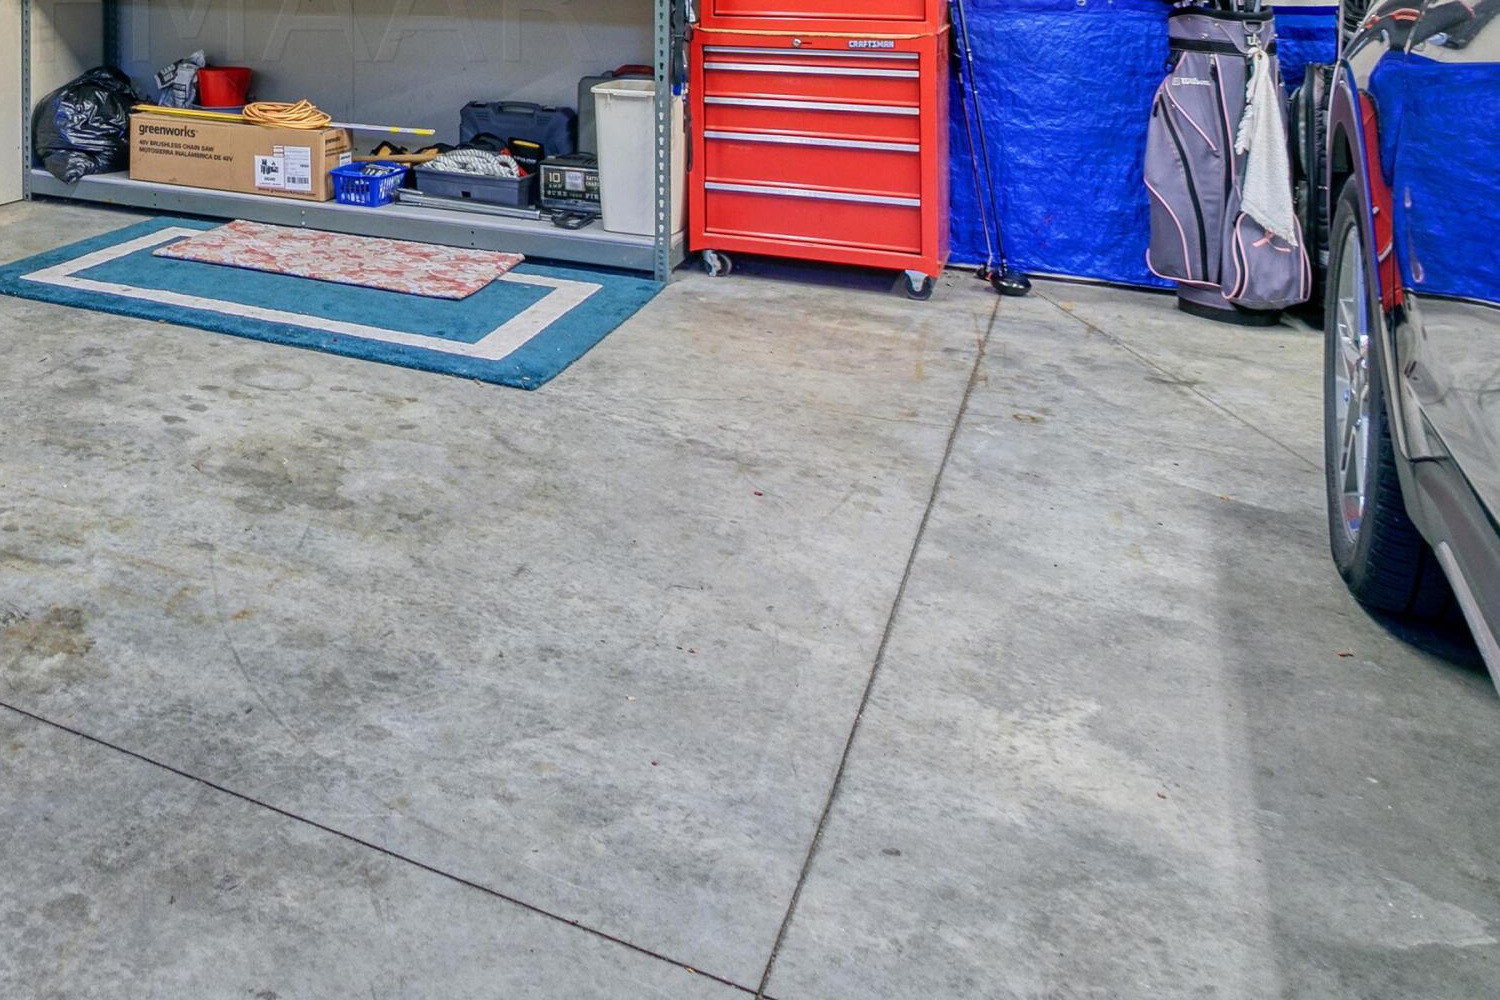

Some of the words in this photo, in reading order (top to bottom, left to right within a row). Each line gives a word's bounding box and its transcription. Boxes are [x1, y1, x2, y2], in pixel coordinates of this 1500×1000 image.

[848, 40, 894, 48] CRAFTSMAN
[139, 123, 196, 138] greenworks
[139, 146, 174, 156] MOTOSIERRA
[150, 140, 182, 150] BRUSHLESS
[183, 143, 200, 151] CHAIN
[549, 172, 561, 183] 10
